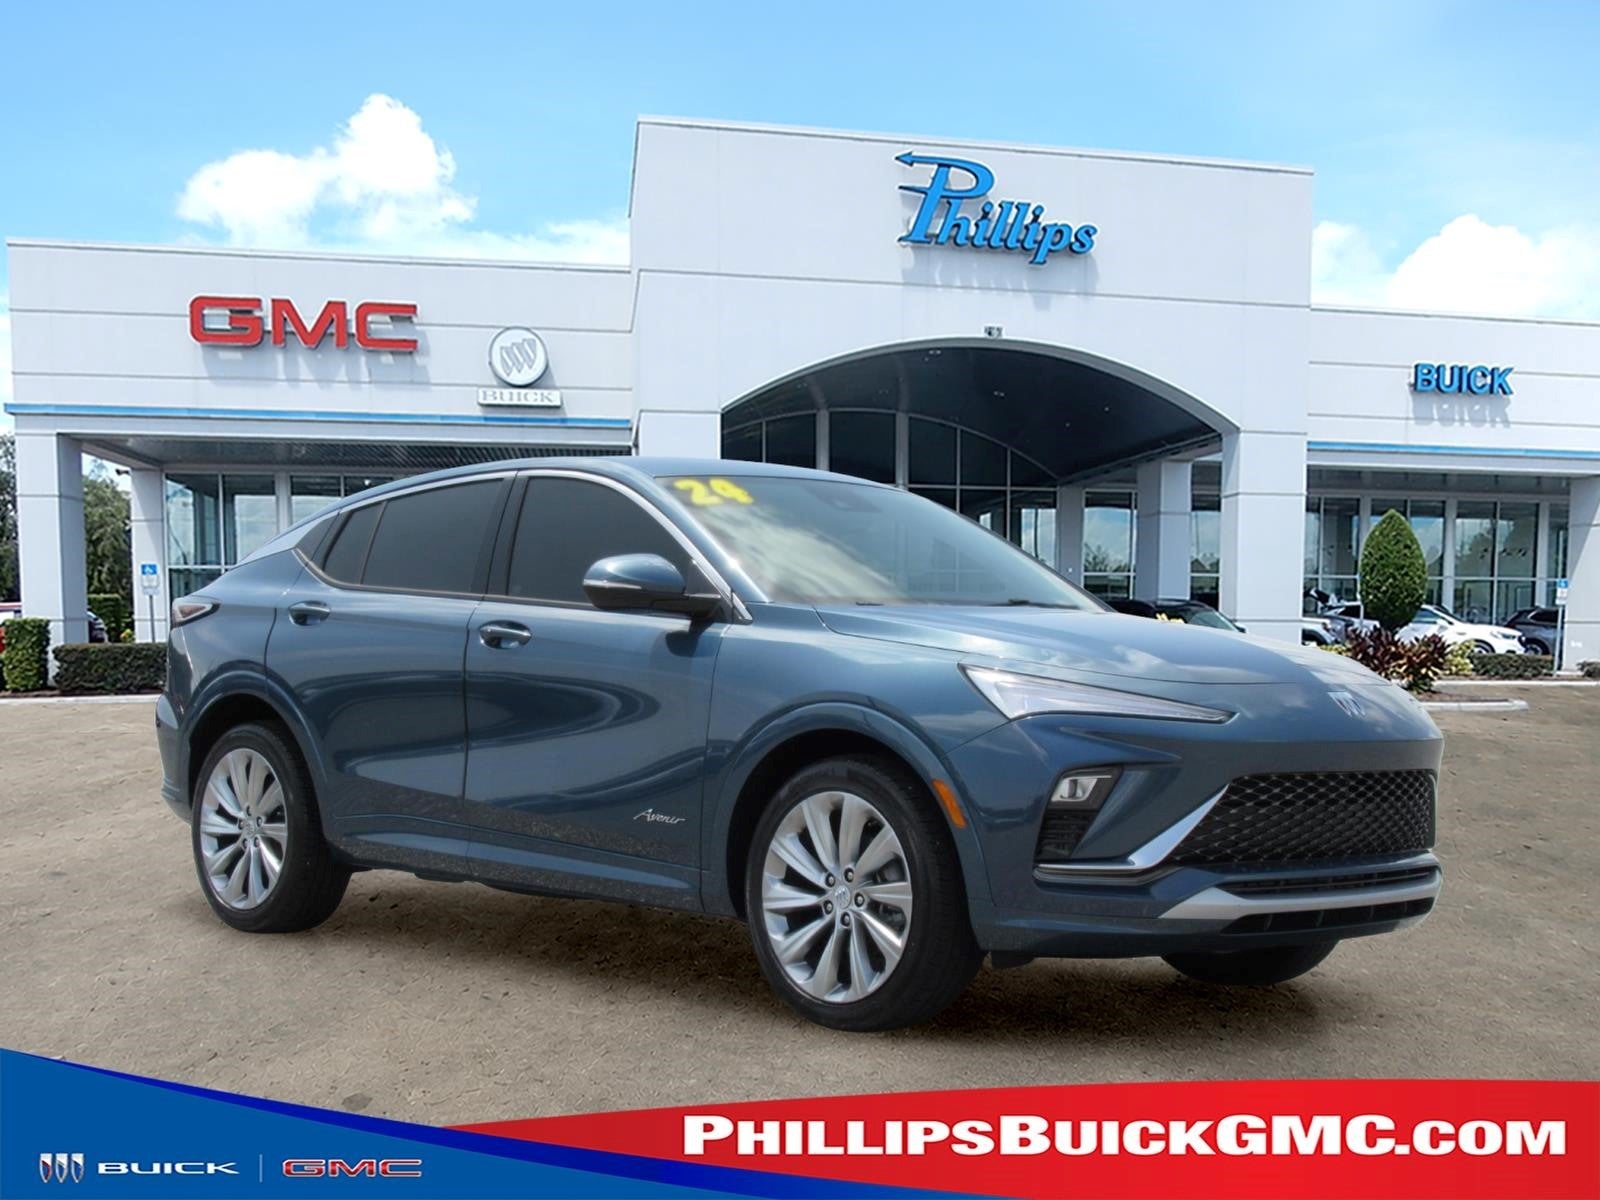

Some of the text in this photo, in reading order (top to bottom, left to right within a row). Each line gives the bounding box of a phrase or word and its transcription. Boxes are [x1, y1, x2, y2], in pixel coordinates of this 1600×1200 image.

[895, 152, 1098, 265] Phillips
[190, 296, 418, 353] GMC
[1414, 363, 1514, 395] BUICK
[481, 390, 556, 404] BUICK
[673, 478, 754, 505] 24
